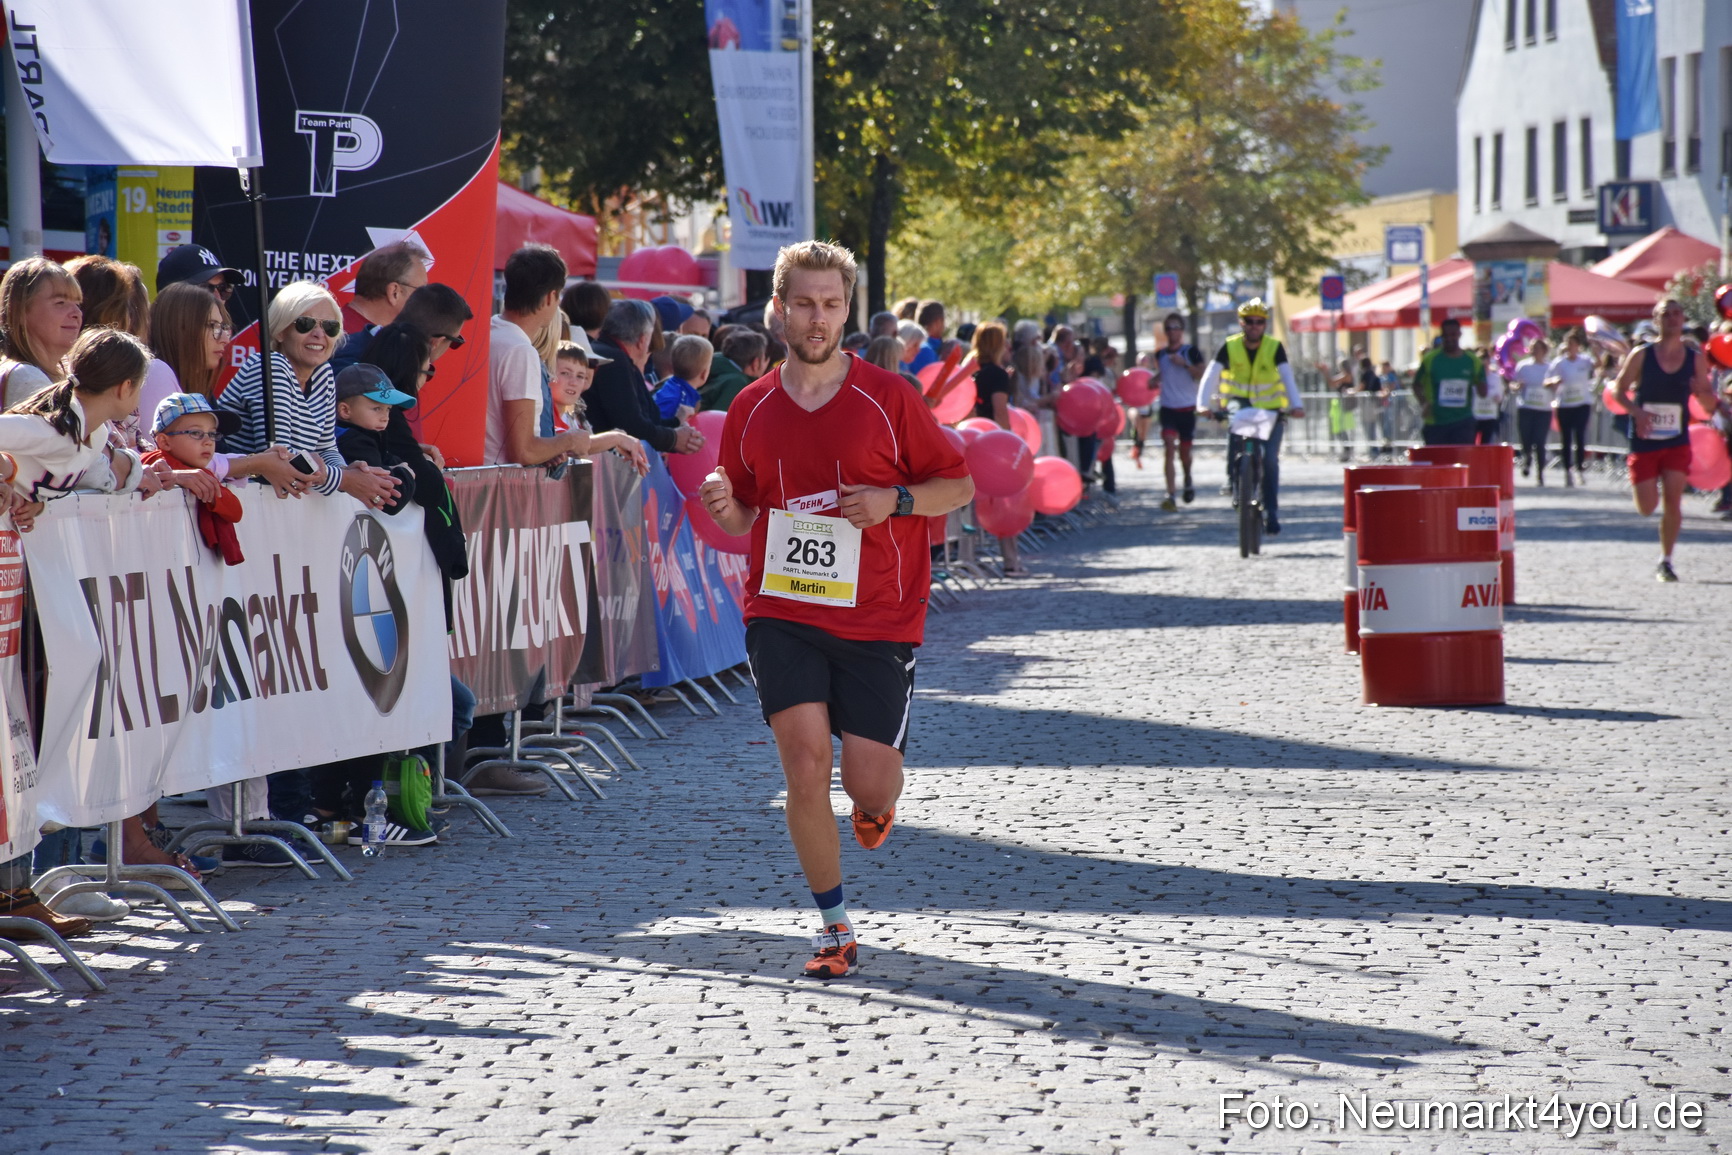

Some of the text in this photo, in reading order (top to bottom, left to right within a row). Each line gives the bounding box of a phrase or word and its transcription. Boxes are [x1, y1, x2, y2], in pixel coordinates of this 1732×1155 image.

[301, 117, 351, 129] Team Partl
[122, 187, 154, 213] 19.
[264, 251, 355, 273] THE NEXT
[800, 497, 824, 511] DEHN
[792, 520, 834, 533] BOCK
[786, 536, 836, 568] 263
[782, 566, 830, 578] PARTL Neumarkt
[790, 579, 826, 594] Martin
[1461, 577, 1501, 609] AVI
